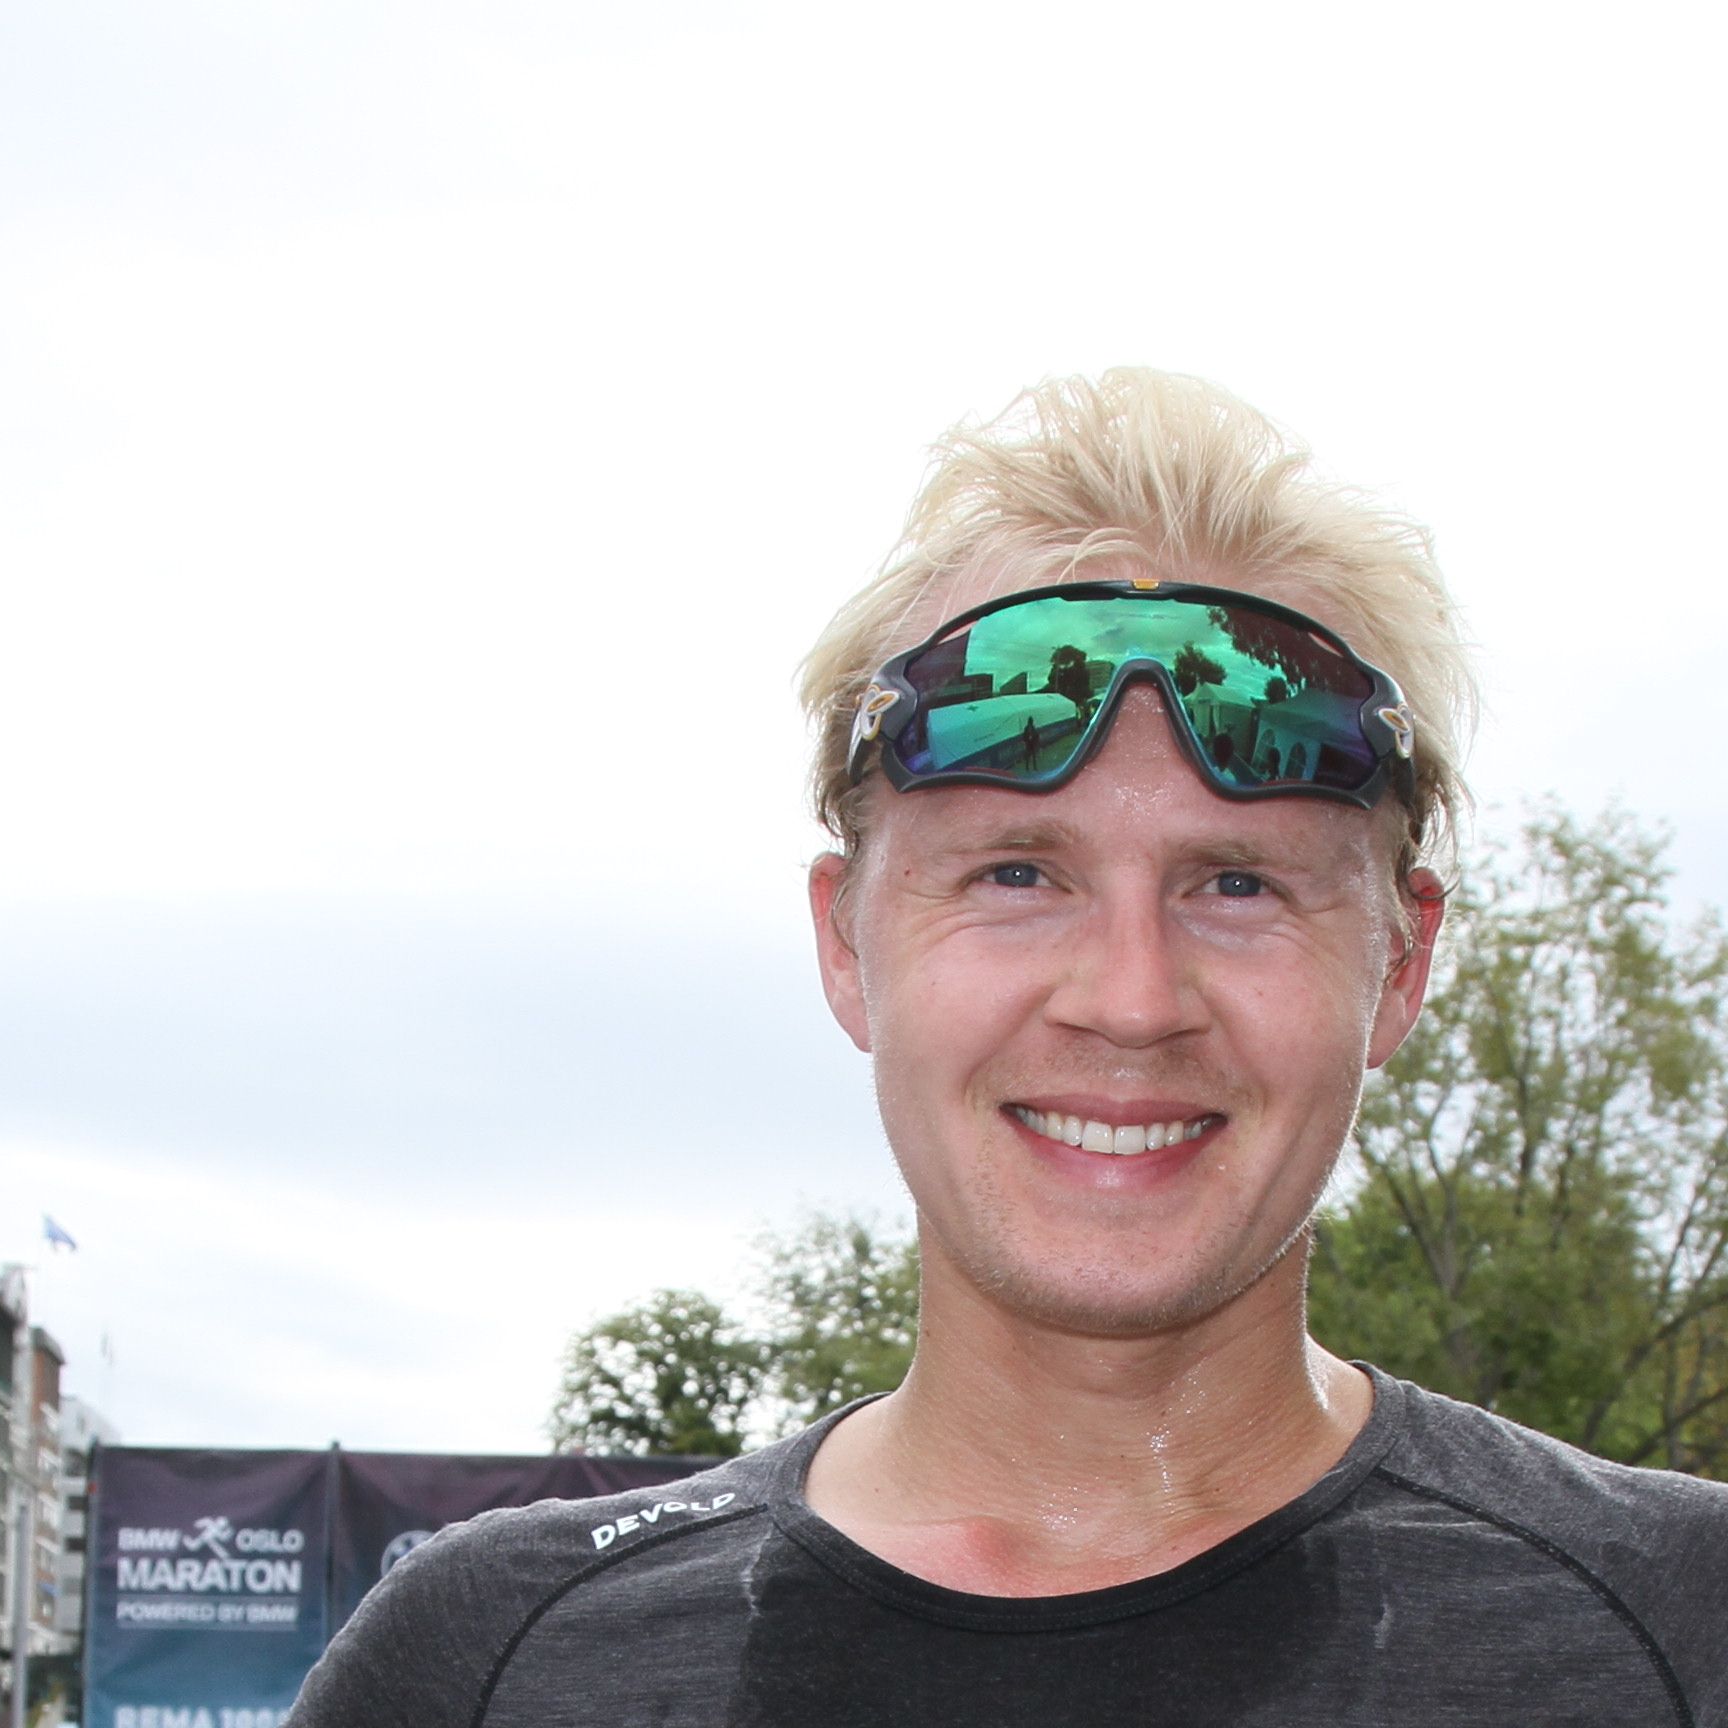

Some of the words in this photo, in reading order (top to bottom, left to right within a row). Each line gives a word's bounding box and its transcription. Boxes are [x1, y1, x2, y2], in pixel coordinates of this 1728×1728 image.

[591, 1493, 736, 1550] DEVOLD
[117, 1527, 180, 1551] BMW
[235, 1528, 305, 1552] OSLO
[116, 1557, 303, 1593] MARATON
[116, 1601, 216, 1621] POWERED
[218, 1603, 244, 1621] BY
[246, 1604, 299, 1623] BMW
